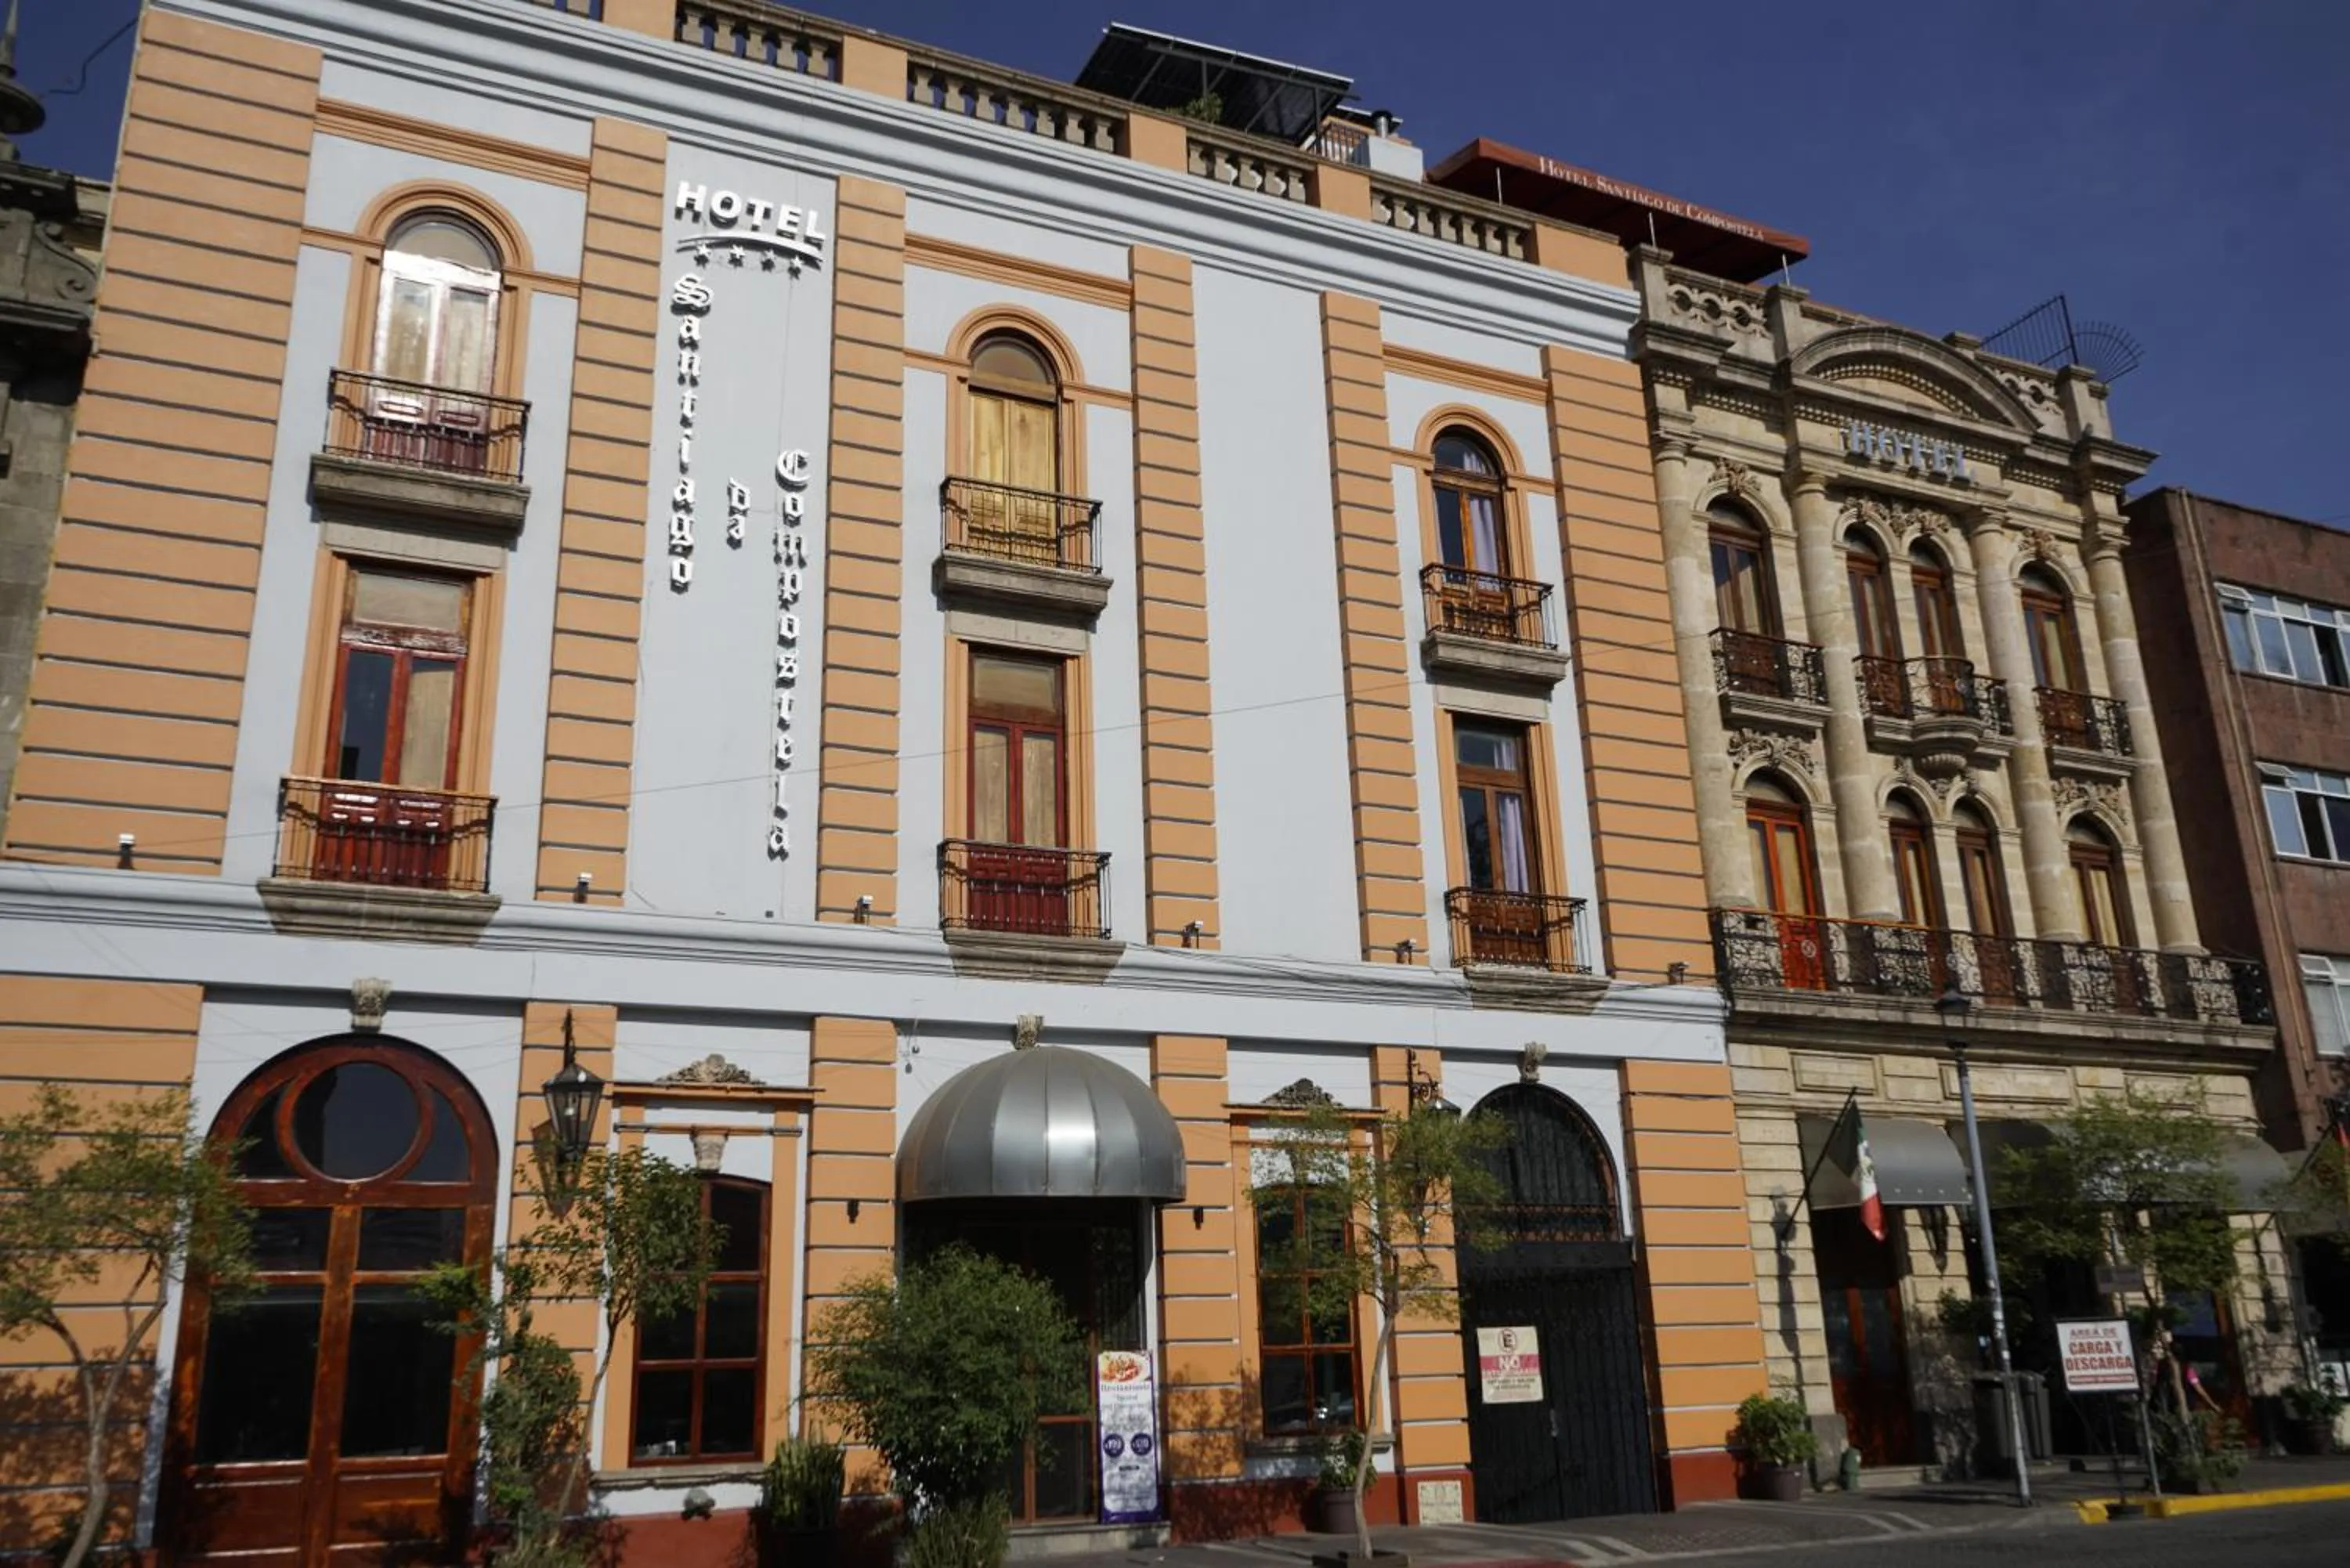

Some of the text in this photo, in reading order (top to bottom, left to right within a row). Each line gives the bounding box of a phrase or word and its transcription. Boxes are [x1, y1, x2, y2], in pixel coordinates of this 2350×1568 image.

[675, 181, 826, 241] HOTEL
[1539, 156, 1593, 190] HOTEL
[1596, 175, 1664, 210] SANTIAGO
[670, 272, 714, 587] Santiago
[1846, 422, 1976, 484] HOTEL
[727, 476, 752, 542] de
[767, 448, 811, 857] Compostela
[1498, 1355, 1521, 1370] NO
[2065, 1356, 2135, 1371] DESCARGA
[2069, 1340, 2123, 1355] CARGA Y
